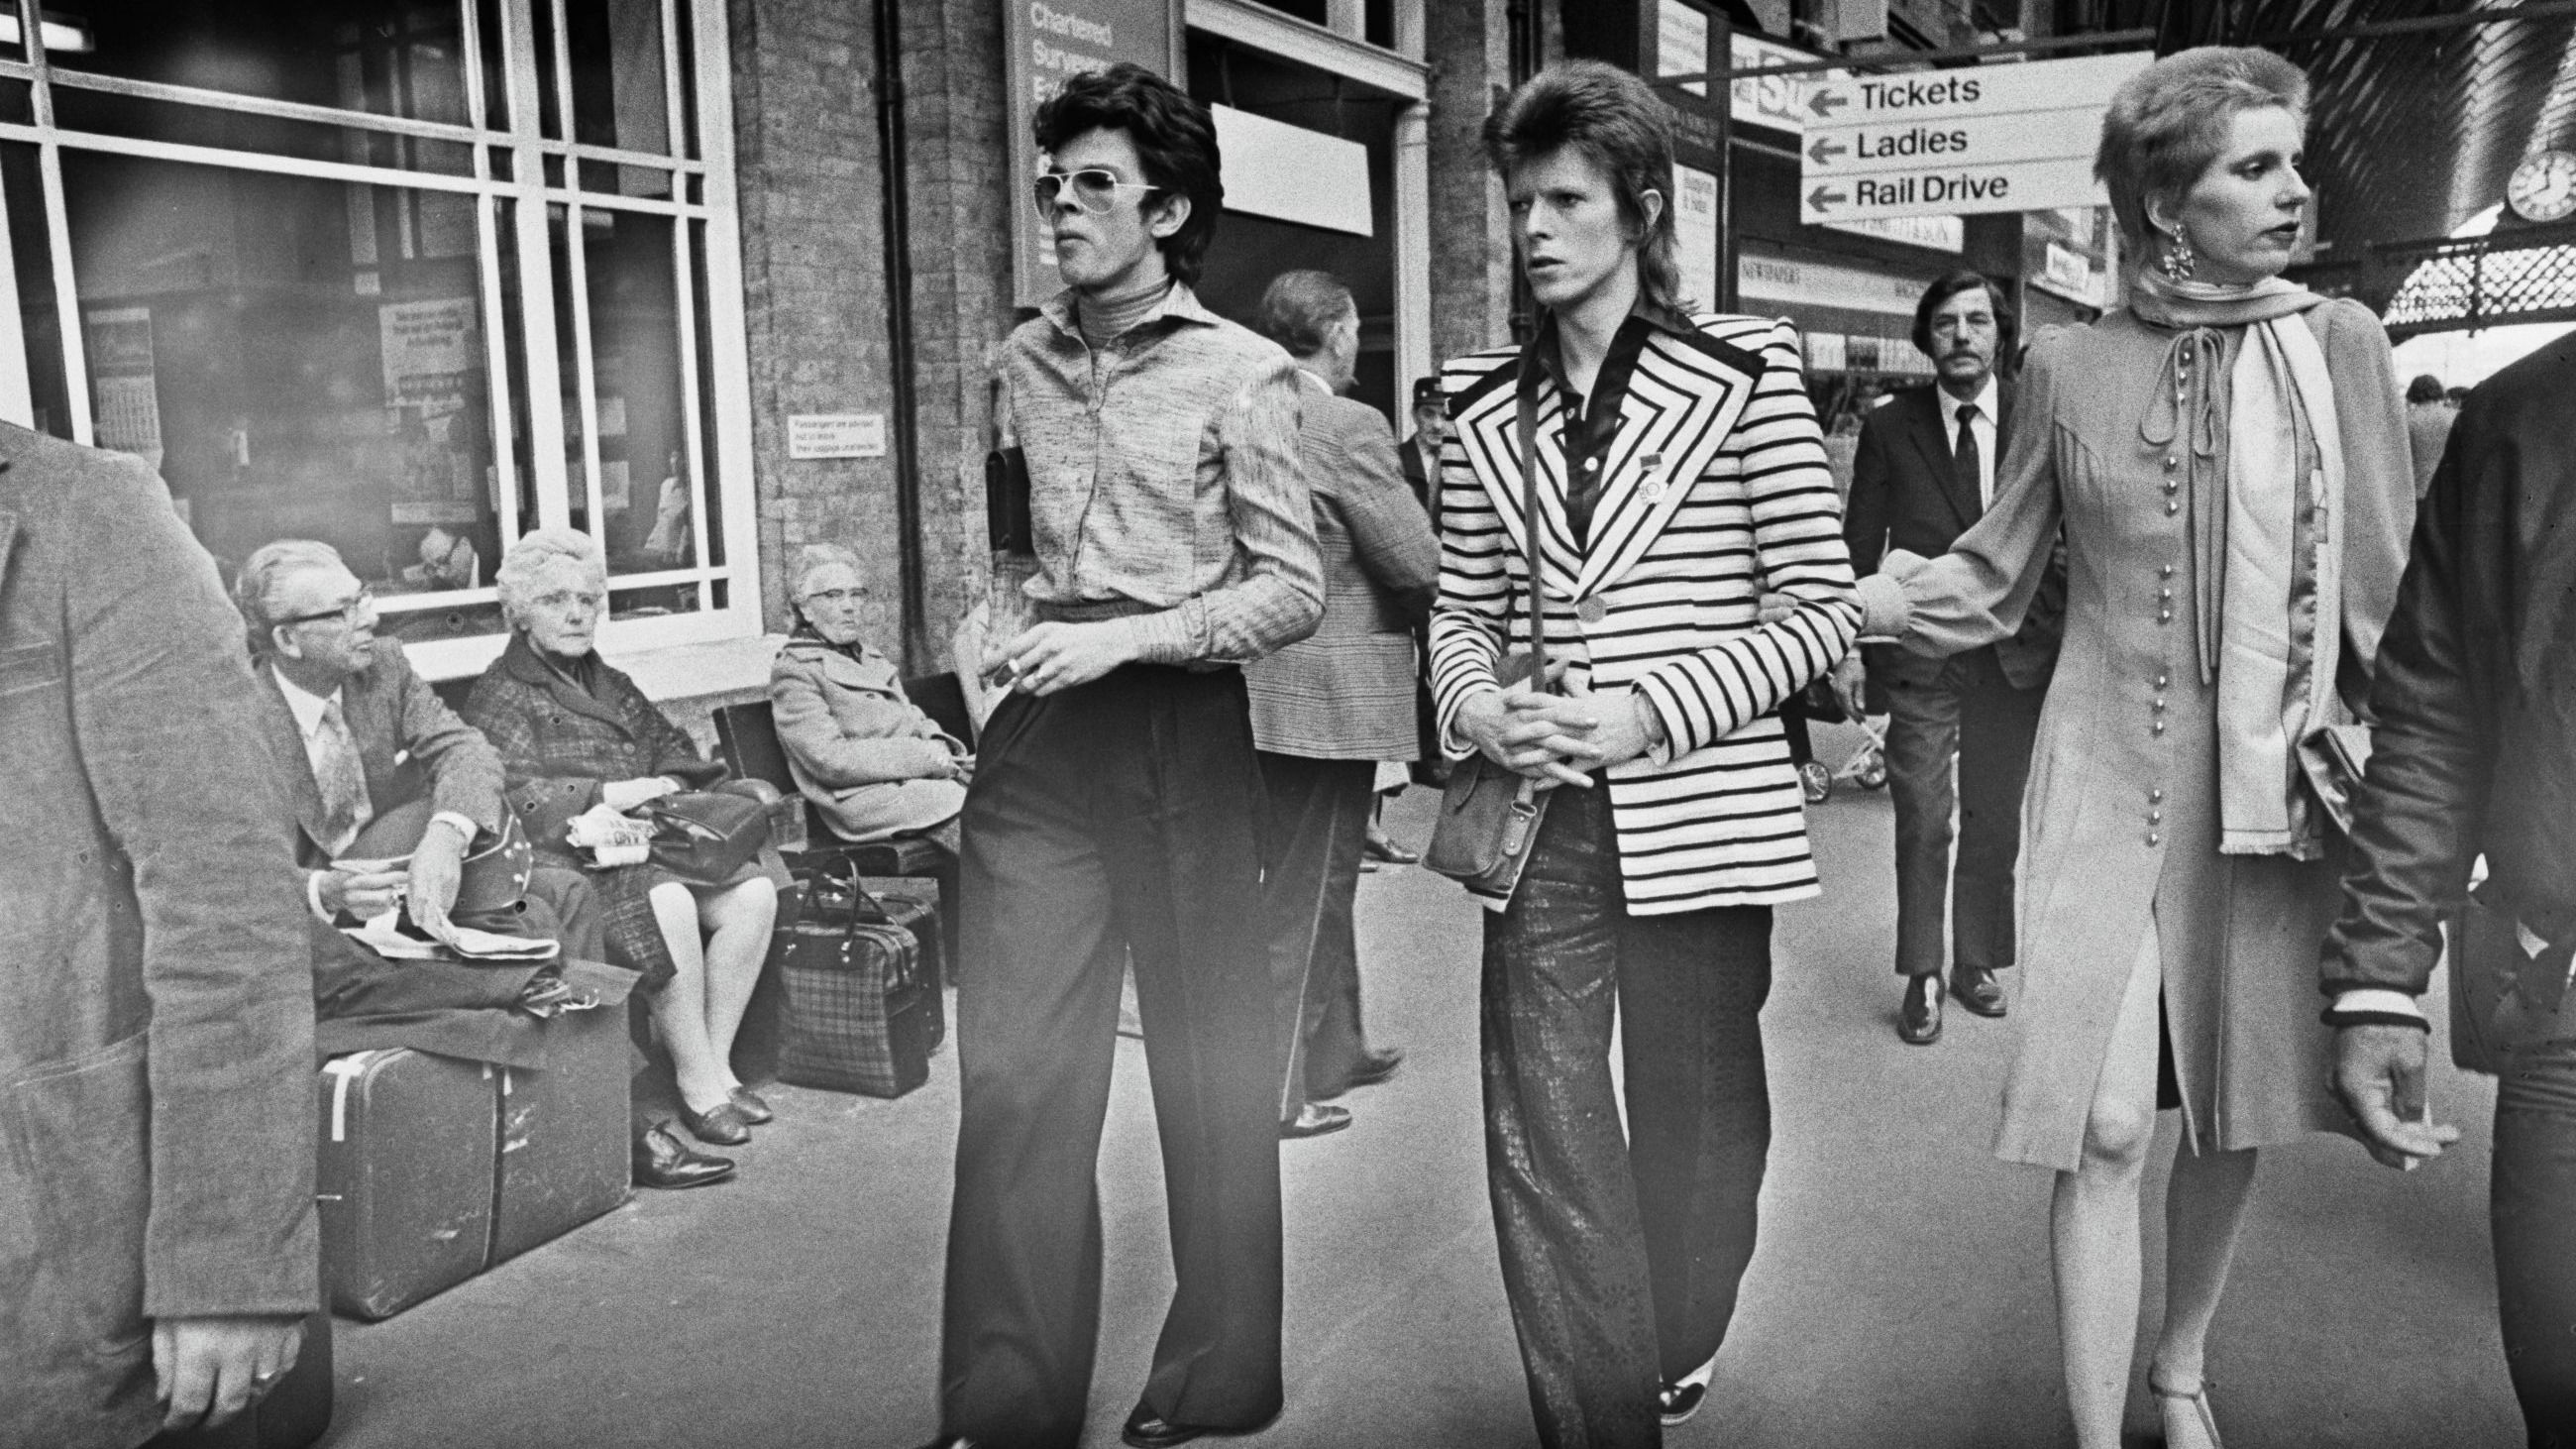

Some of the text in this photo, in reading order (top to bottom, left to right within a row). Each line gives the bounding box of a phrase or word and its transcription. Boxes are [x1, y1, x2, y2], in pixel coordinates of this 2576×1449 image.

[1029, 1, 1113, 49] Chartered
[1861, 76, 1982, 111] Tickets
[1858, 128, 1969, 159] Ladies
[1856, 174, 2009, 207] Rail Drive
